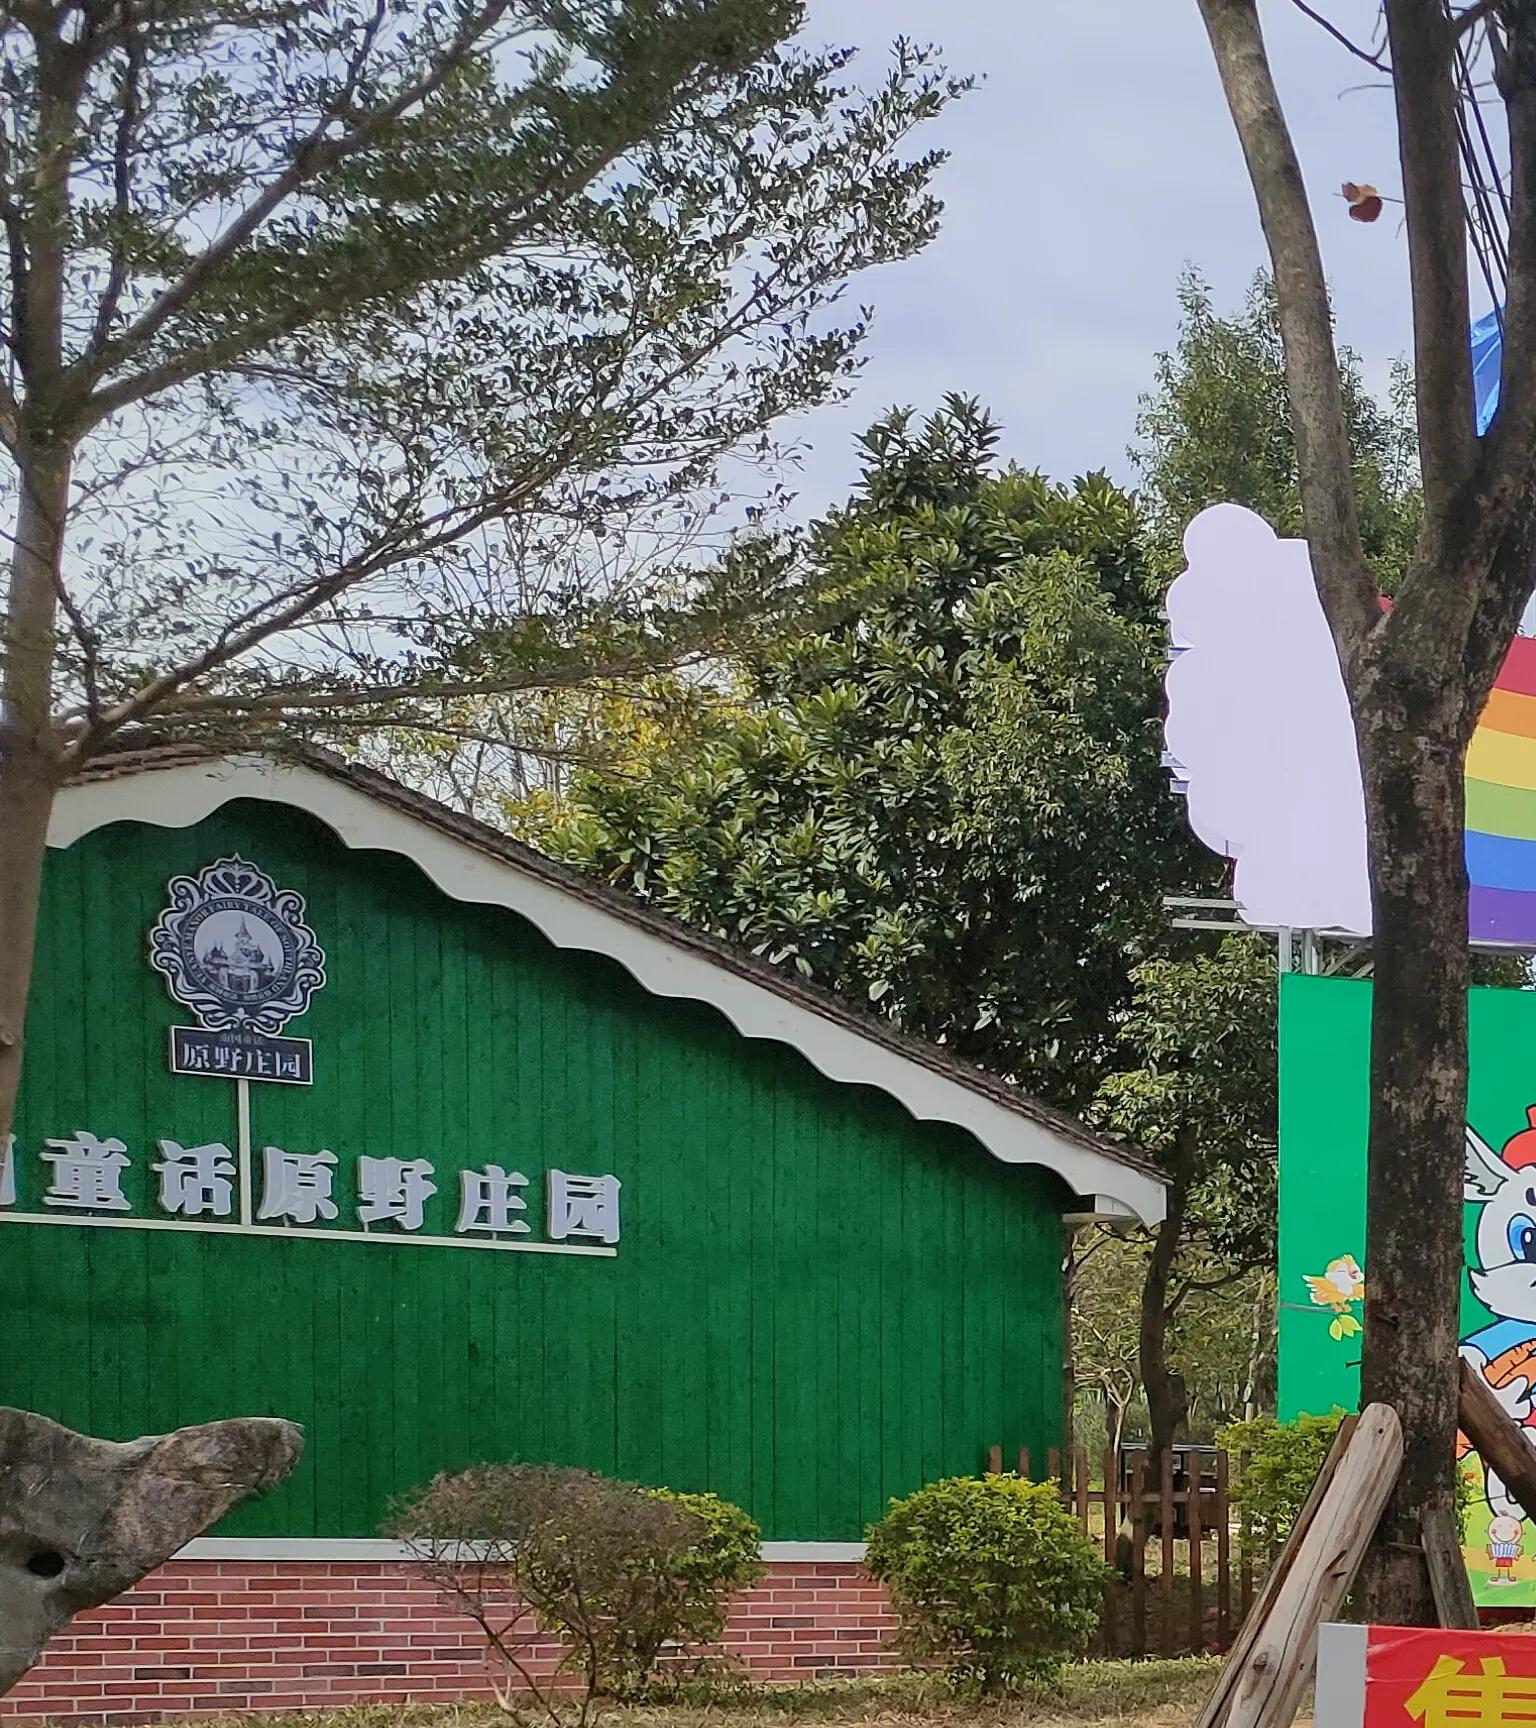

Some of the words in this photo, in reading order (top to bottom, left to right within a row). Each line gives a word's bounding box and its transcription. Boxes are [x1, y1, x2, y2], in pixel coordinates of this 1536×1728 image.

[182, 1042, 301, 1078] 原野庄园
[0, 1130, 622, 1244] 童话原野庄园
